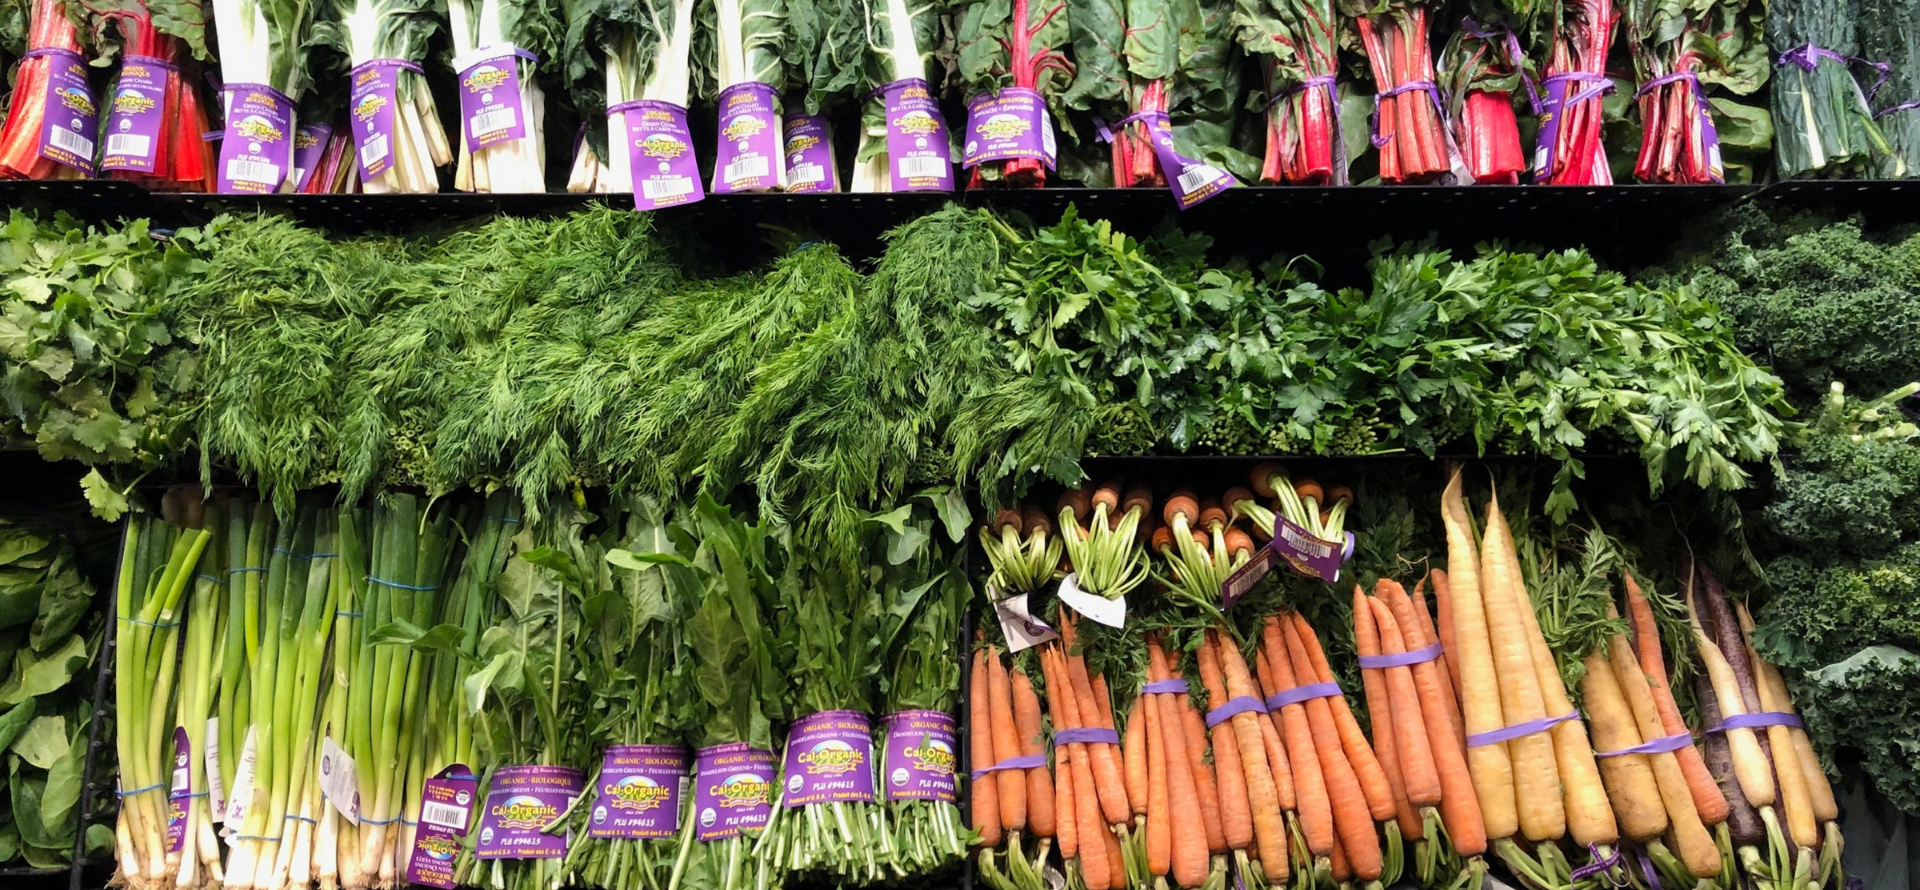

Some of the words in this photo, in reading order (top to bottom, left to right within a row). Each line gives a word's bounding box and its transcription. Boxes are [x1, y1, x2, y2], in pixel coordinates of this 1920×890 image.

[803, 722, 834, 733] ORGANIC
[714, 755, 745, 765] ORGANIC
[798, 749, 863, 763] Cal-Organic
[644, 758, 682, 766] BIOLOGIQU
[500, 777, 528, 785] ORGANIC
[812, 782, 826, 791] PLU
[827, 781, 855, 789] #94615
[919, 780, 932, 788] PLU
[932, 780, 954, 791] #94615
[604, 784, 669, 798] Cal-Organic
[709, 781, 770, 797] Cal-Organi
[491, 804, 557, 817] Cal-Organic
[725, 817, 739, 825] PLU
[741, 814, 766, 824] #94615
[414, 862, 437, 871] ONIONS
